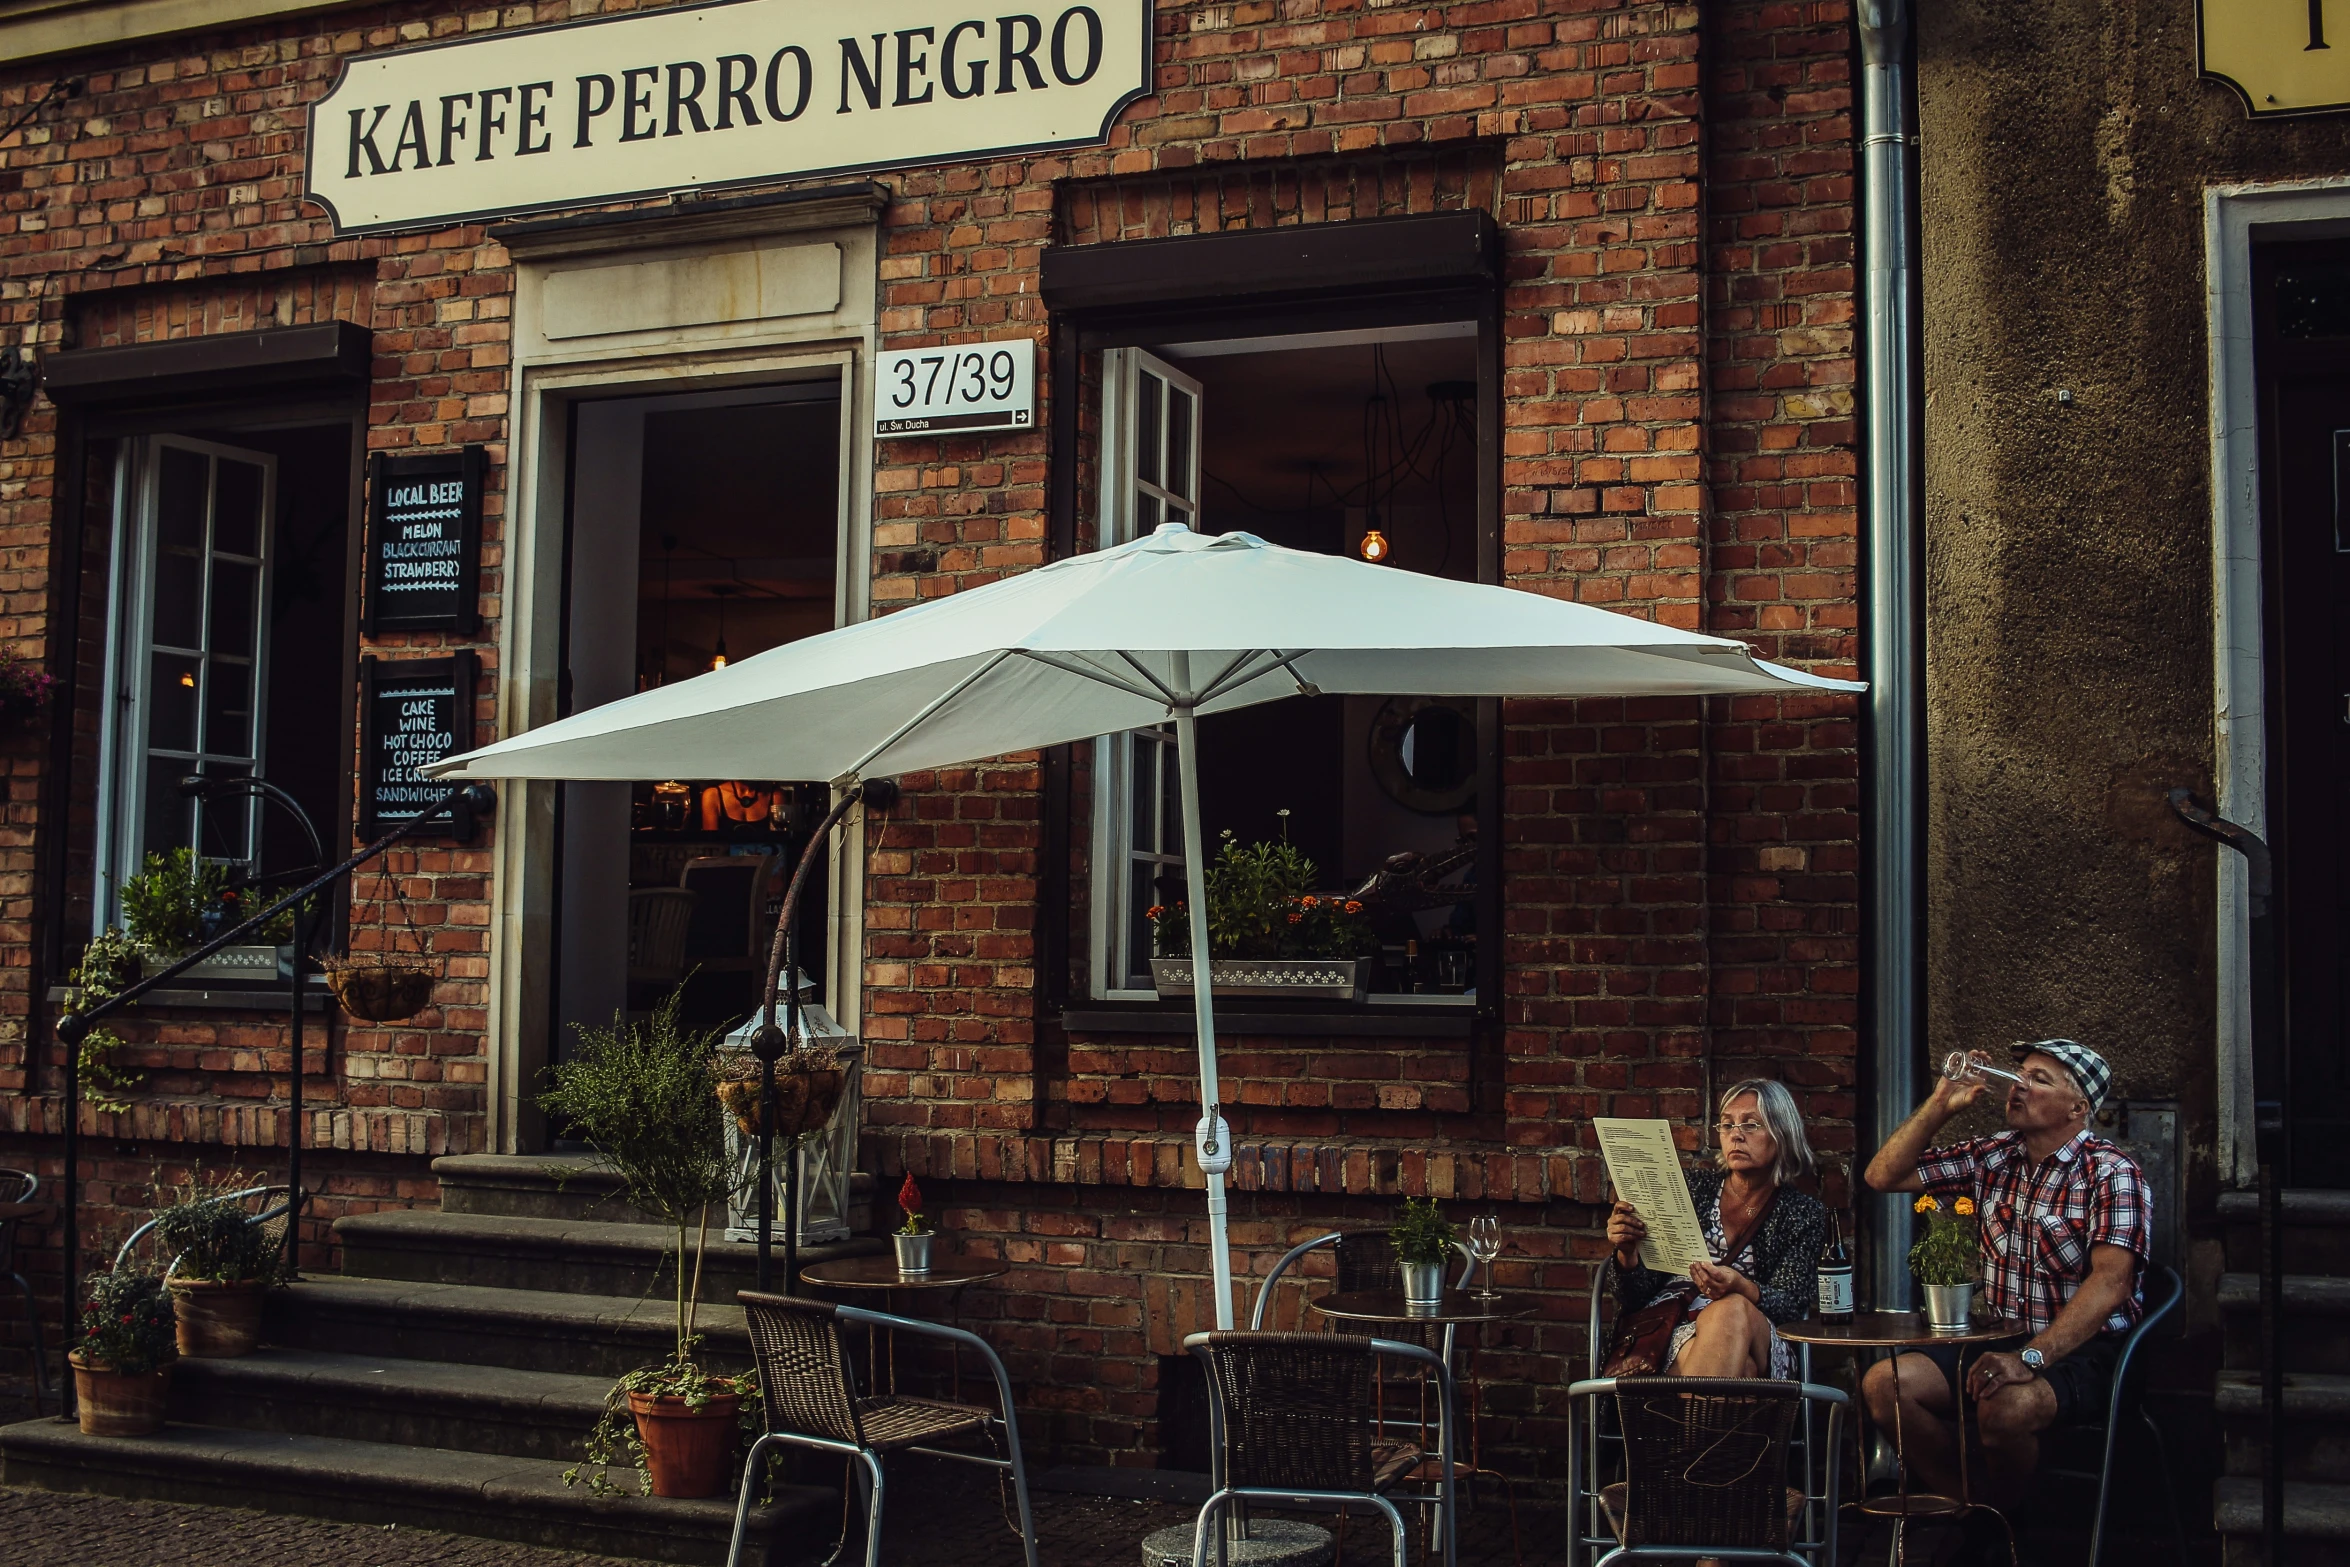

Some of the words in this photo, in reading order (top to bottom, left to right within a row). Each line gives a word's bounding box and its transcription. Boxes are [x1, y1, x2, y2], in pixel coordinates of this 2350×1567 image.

[345, 80, 554, 178] KAFFE
[573, 46, 813, 149] PERRO
[837, 5, 1104, 115] NEGRO
[892, 350, 1015, 408] 37/39
[879, 422, 889, 432] ul.
[890, 419, 904, 431] Św.
[905, 419, 930, 430] Ducha
[388, 484, 428, 507] LOCAL
[429, 481, 463, 504] BEER
[402, 522, 442, 540] MELON
[382, 540, 461, 559] BLACKCURRANT
[401, 699, 435, 716] CAKE
[399, 716, 436, 732] WINE
[383, 734, 408, 750] HOT
[409, 732, 453, 749] CHOCO
[393, 750, 441, 766] COFFEE
[383, 767, 402, 782] ICE
